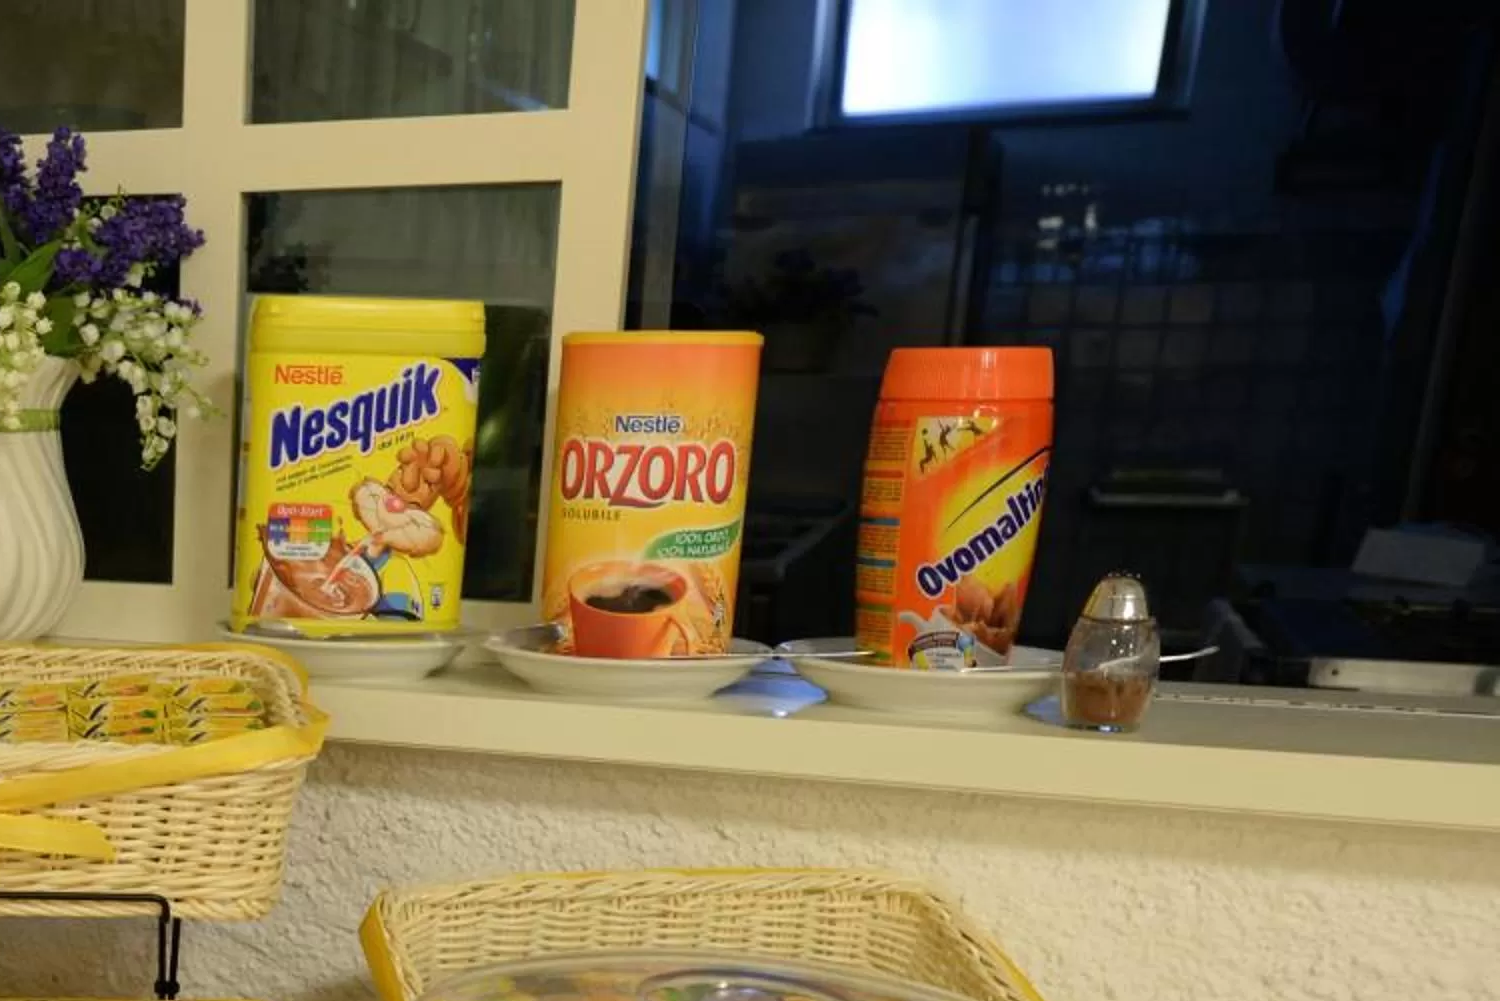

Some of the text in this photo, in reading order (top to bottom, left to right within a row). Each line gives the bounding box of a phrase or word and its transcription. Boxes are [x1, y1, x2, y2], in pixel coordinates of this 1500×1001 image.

[270, 363, 440, 468] Nesquik
[560, 438, 736, 509] ORZORO
[561, 507, 622, 521] SOLUBILE
[917, 468, 1048, 598] Ovomaltin
